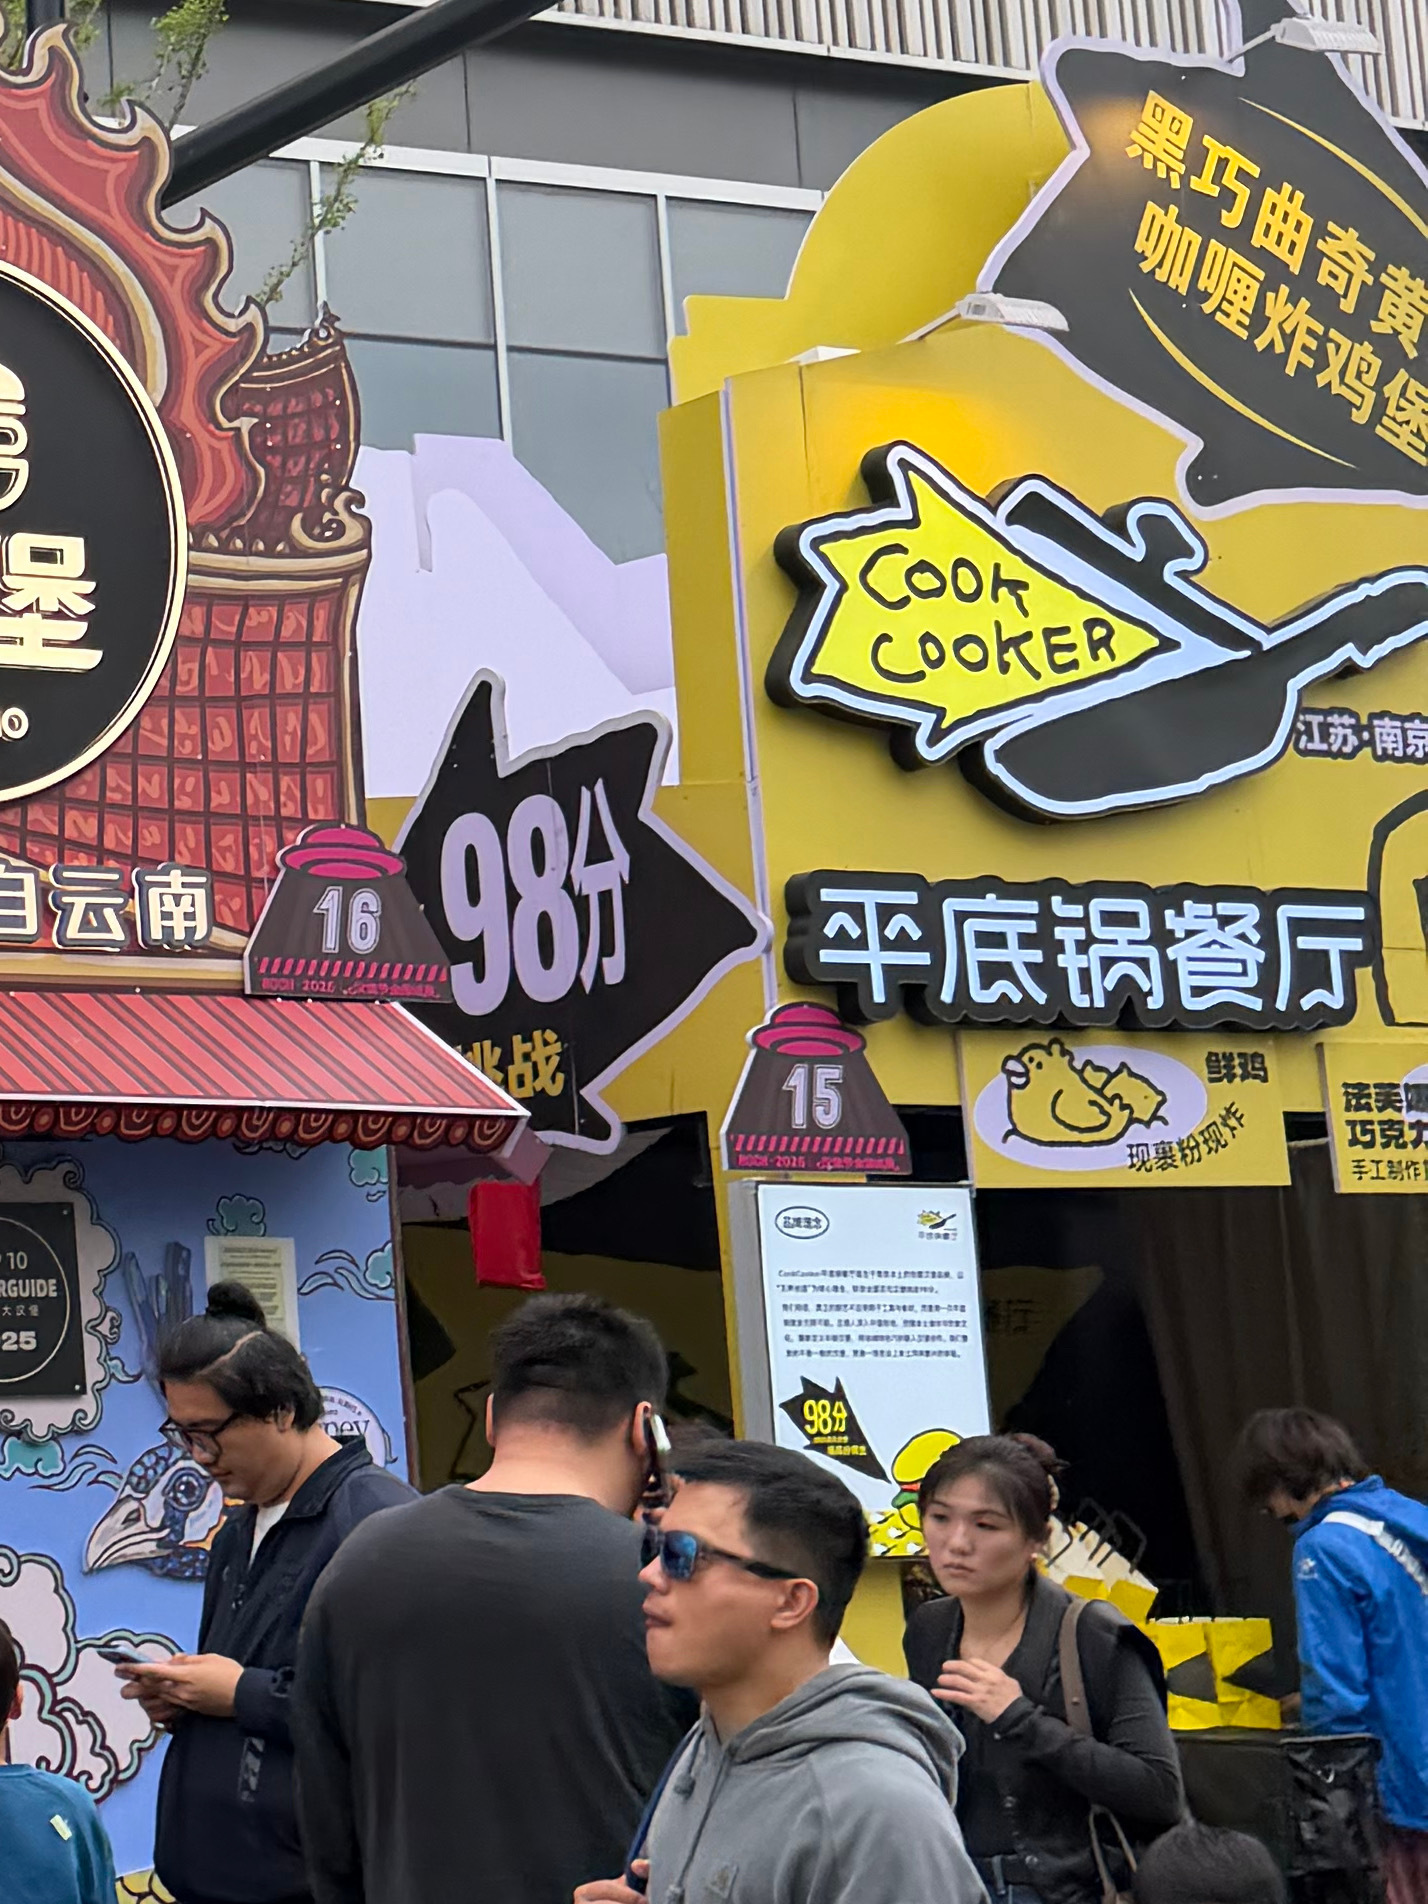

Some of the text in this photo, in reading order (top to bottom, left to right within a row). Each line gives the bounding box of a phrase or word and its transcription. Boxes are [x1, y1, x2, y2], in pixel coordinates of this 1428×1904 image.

[871, 616, 1118, 684] COOKER
[313, 886, 382, 954] 16
[440, 777, 631, 1016] 98分
[818, 887, 1366, 1012] 平底锅餐厅
[782, 1063, 844, 1129] 15
[1204, 1051, 1270, 1084] 鲜鸡
[1125, 1101, 1247, 1173] 现裹粉现炸
[1351, 1158, 1428, 1182] 手工制作
[6, 1251, 28, 1270] 10
[803, 1399, 848, 1435] 98分
